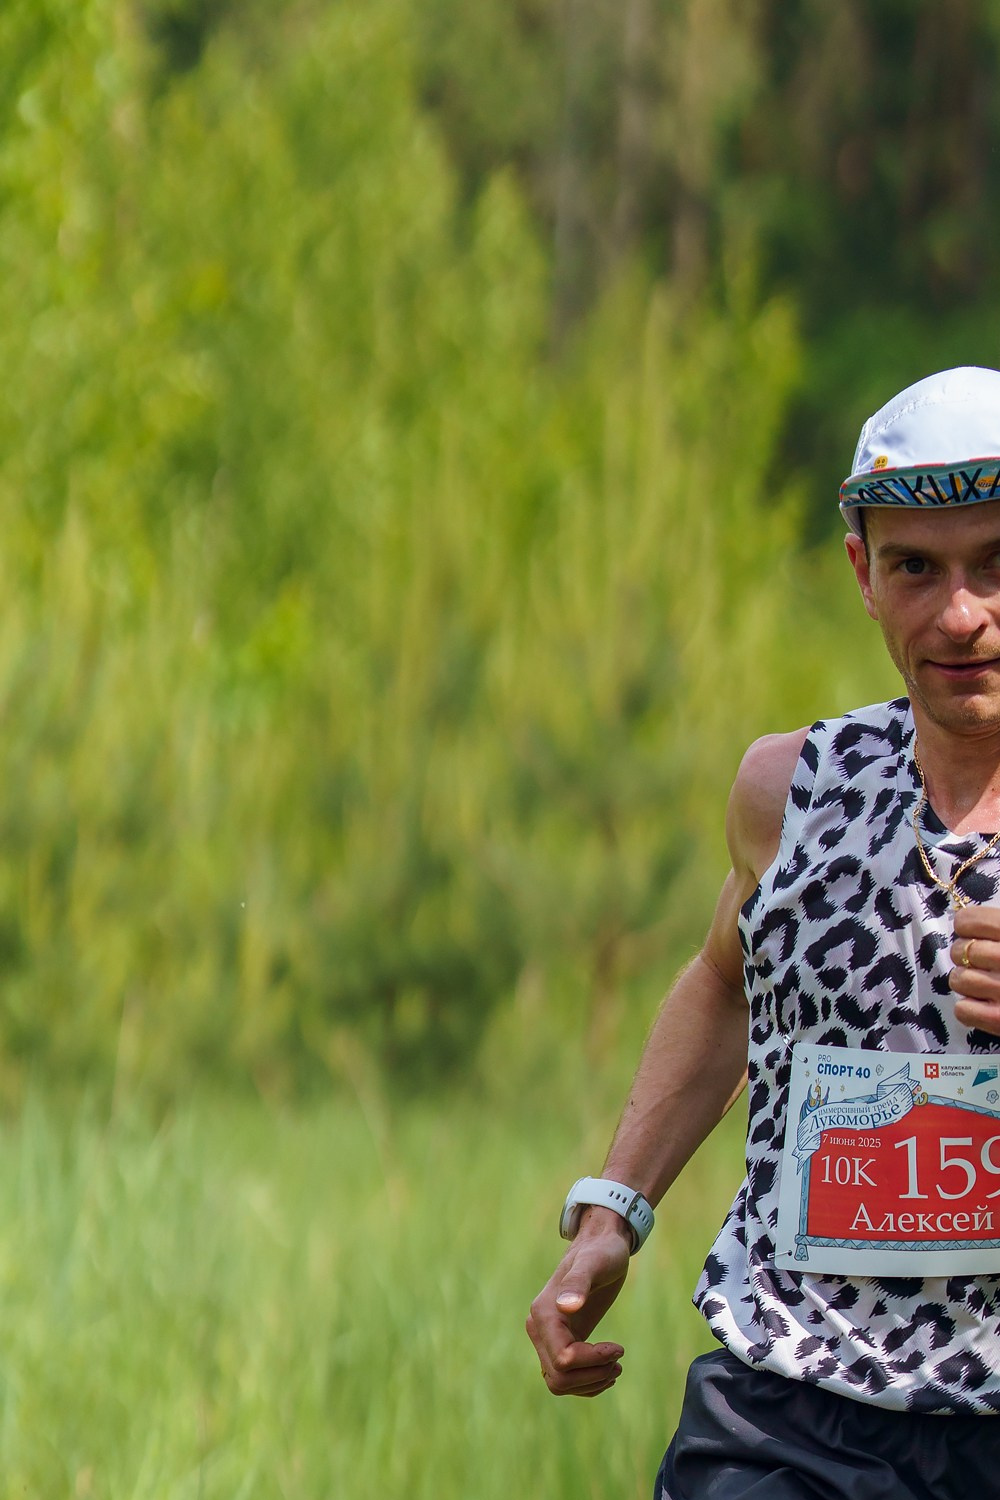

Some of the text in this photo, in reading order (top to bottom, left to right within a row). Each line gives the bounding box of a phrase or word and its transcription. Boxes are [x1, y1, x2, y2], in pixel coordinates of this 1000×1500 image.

[817, 1053, 832, 1063] PRO
[817, 1063, 871, 1079] СПОРТ 40
[818, 1096, 899, 1116] иммерсивный трейл
[809, 1104, 902, 1133] Лукоморье
[822, 1134, 882, 1148] 7 июня 2025
[849, 1203, 995, 1233] Алексей
